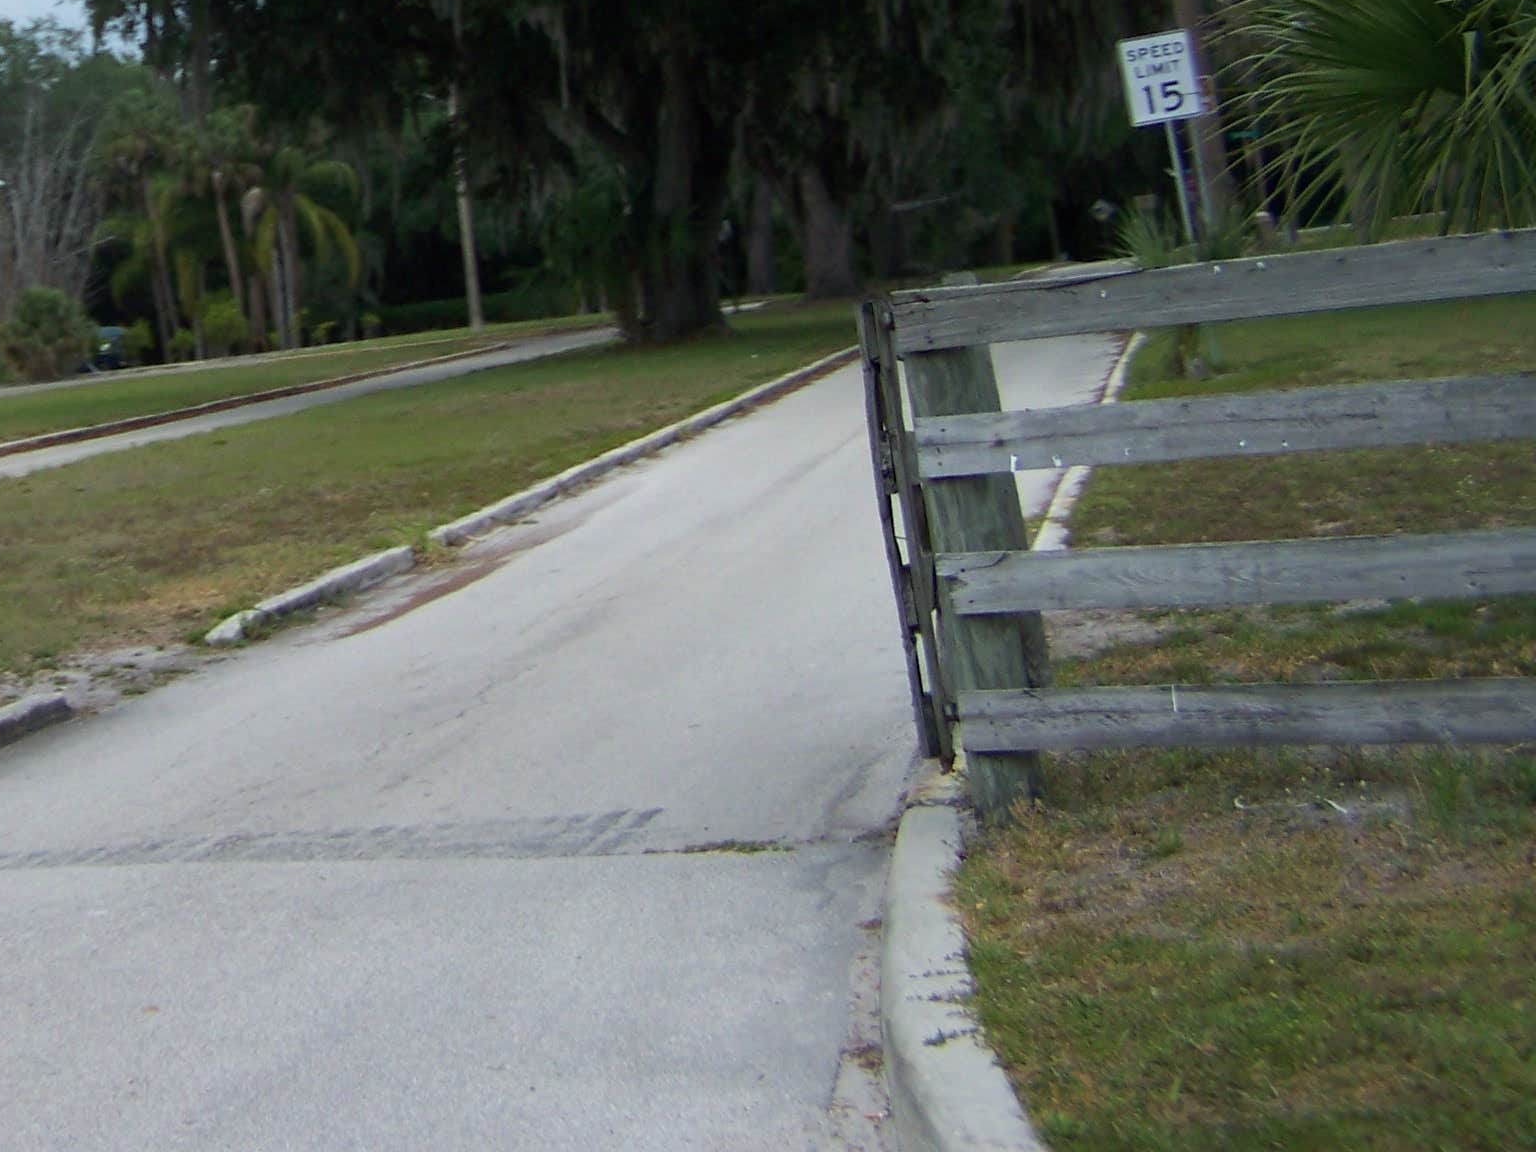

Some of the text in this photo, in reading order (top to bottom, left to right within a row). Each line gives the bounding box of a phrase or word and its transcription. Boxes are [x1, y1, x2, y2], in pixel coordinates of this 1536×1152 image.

[1126, 41, 1184, 62] SPEED
[1134, 59, 1181, 79] LIMIT
[1142, 80, 1184, 115] 15
